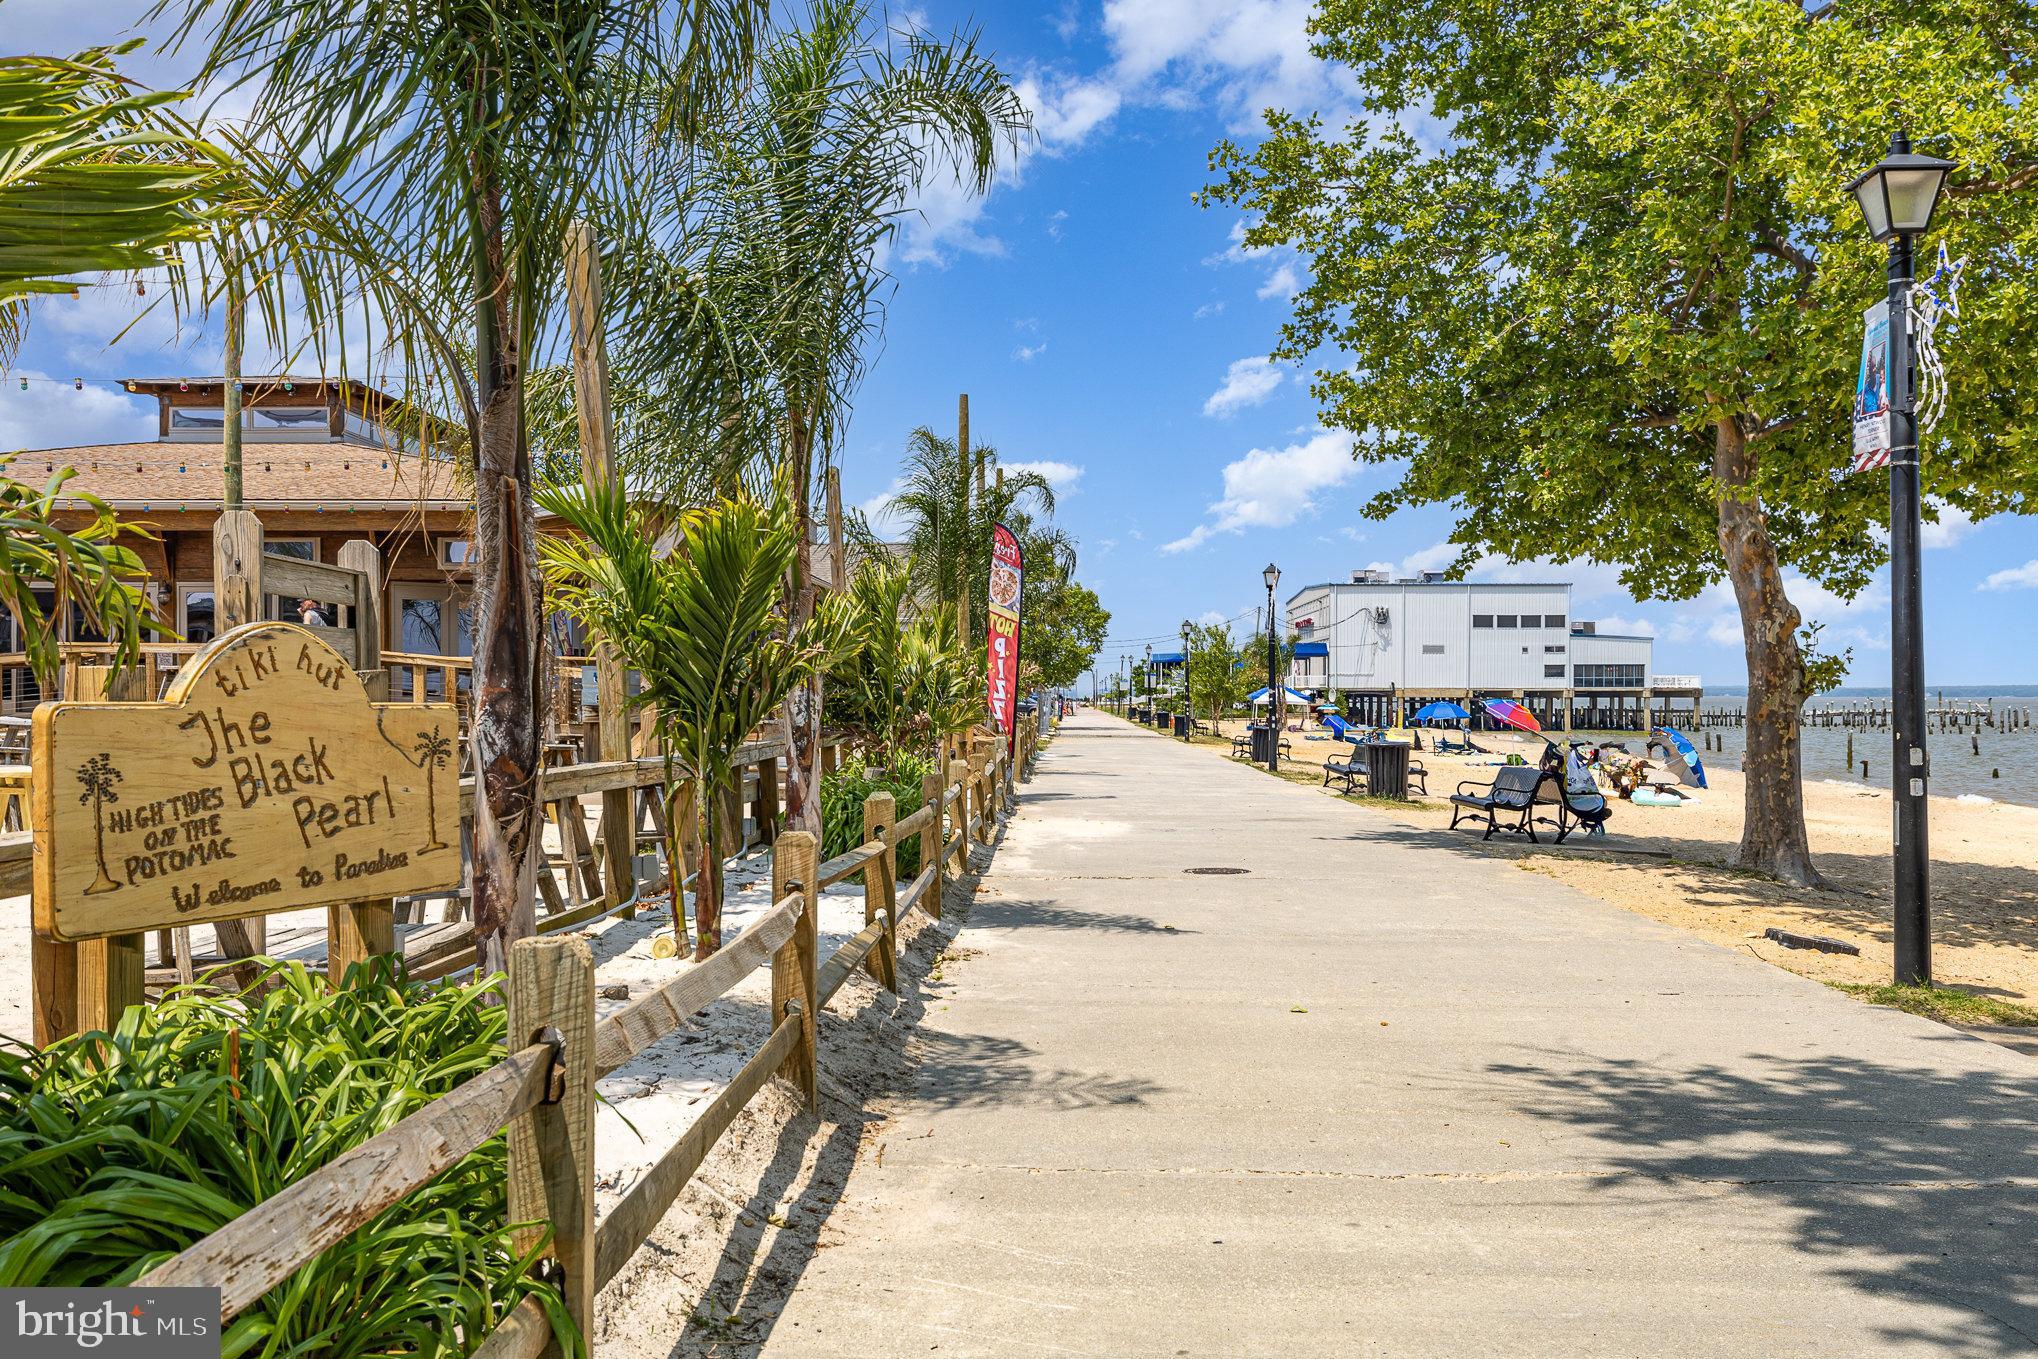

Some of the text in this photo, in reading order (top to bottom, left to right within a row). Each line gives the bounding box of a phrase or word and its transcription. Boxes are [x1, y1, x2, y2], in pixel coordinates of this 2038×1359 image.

[215, 643, 346, 698] tiki hut
[178, 706, 272, 769] The
[229, 736, 335, 809] Black
[108, 786, 225, 834] HIGH TIDES
[144, 814, 223, 851] ON THE
[291, 775, 396, 849] Pearl
[124, 836, 237, 886] POTOMAC
[171, 847, 409, 913] Welcome to Paradise
